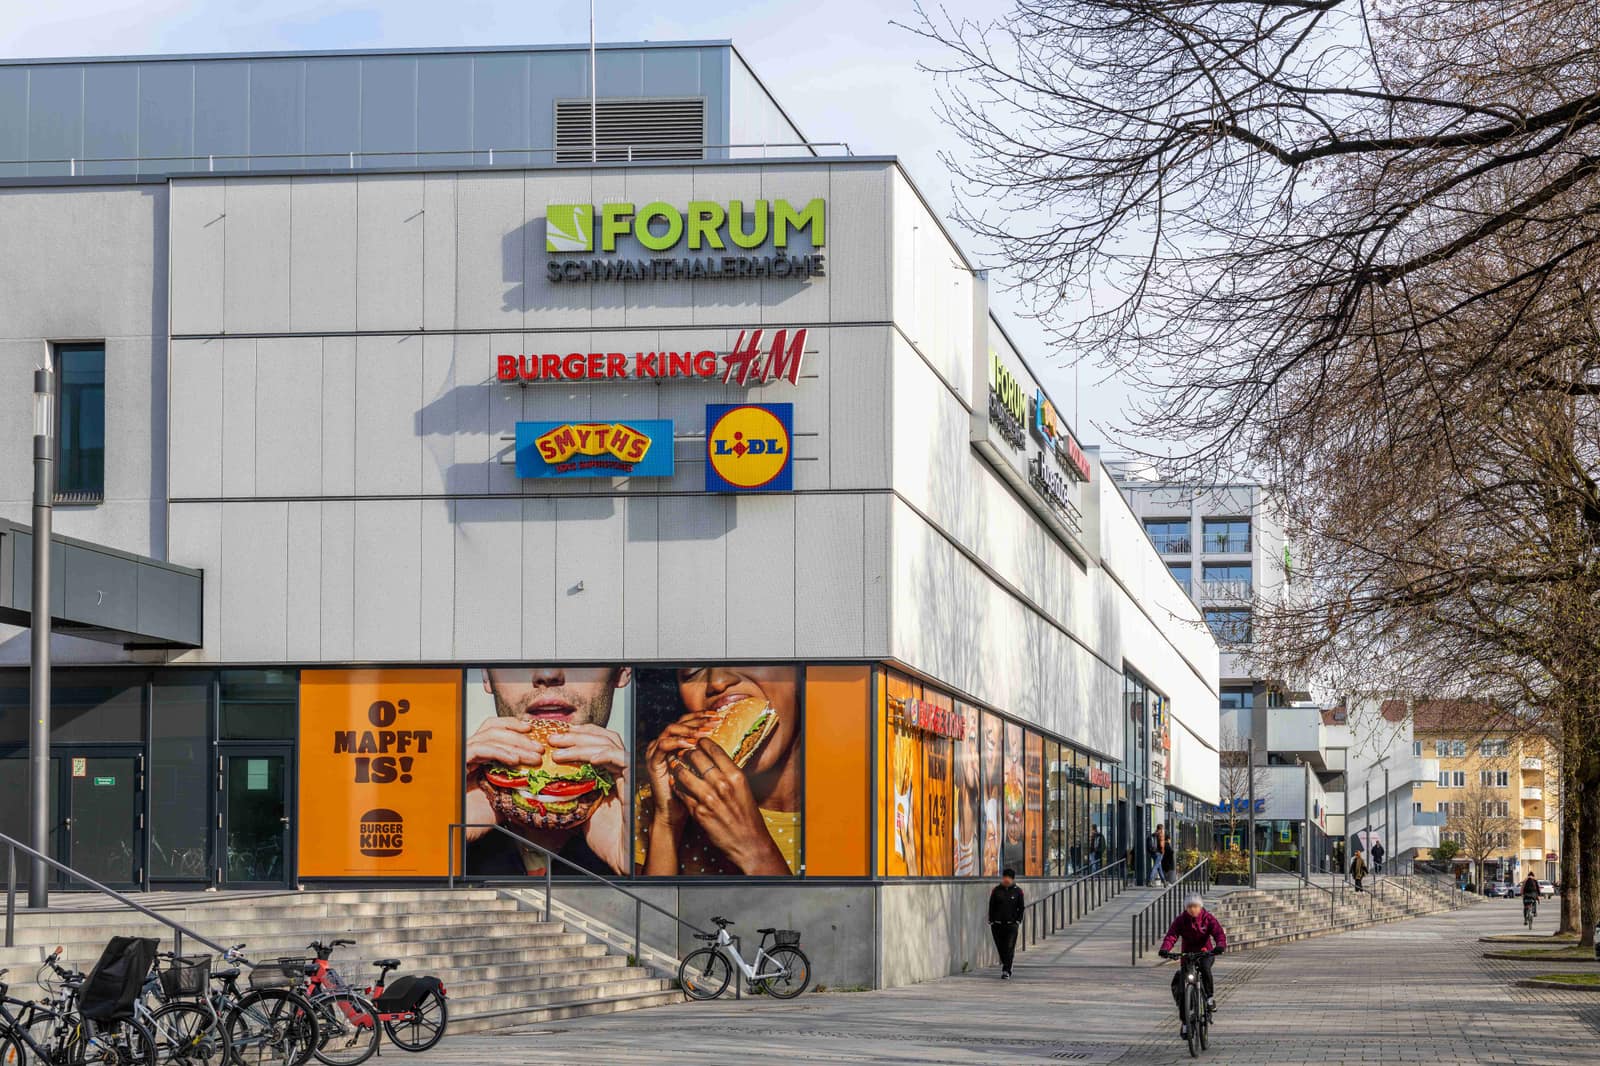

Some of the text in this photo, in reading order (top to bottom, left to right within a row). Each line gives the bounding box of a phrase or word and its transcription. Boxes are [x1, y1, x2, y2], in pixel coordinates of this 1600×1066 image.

[603, 198, 825, 251] FORUM
[546, 253, 826, 283] SCHWANTHALERHÖHE
[497, 351, 716, 380] BURGER KING
[721, 329, 808, 386] H&M
[996, 355, 1027, 430] FORUM
[539, 429, 646, 459] SMYTHS
[333, 731, 432, 754] MAPFT
[354, 756, 414, 784] IS!
[360, 824, 403, 833] BURGER
[360, 834, 403, 848] KING
